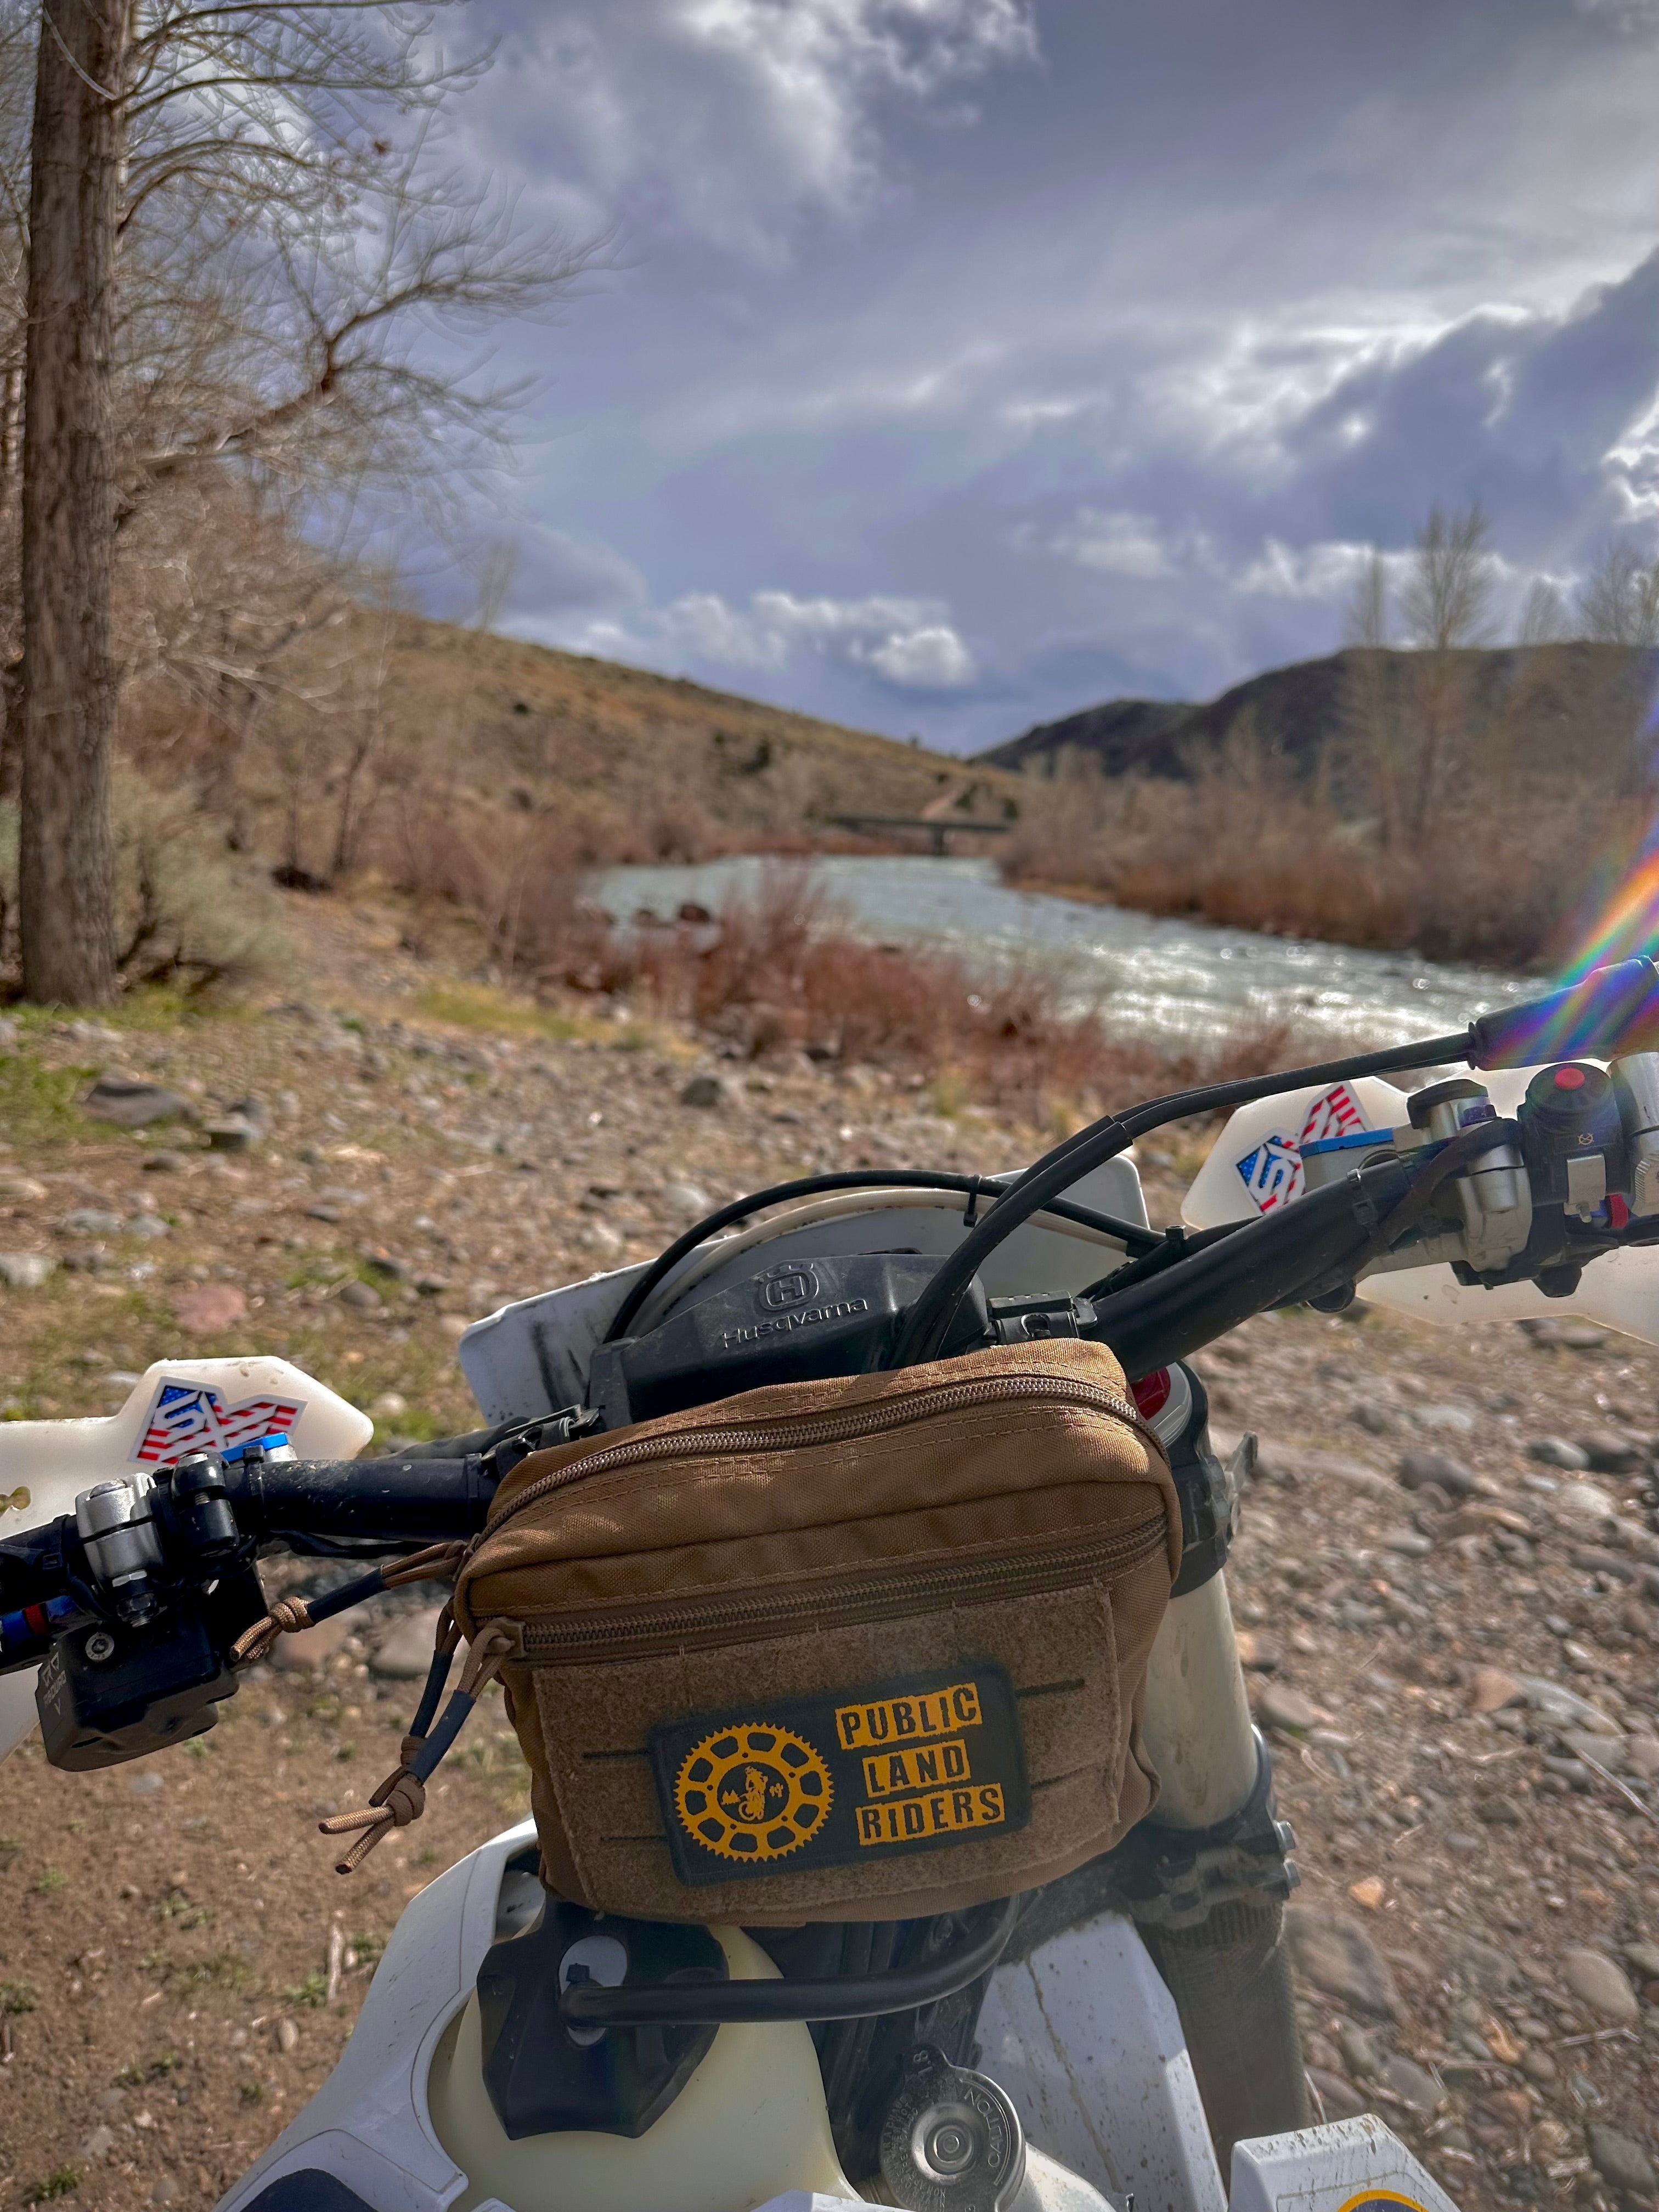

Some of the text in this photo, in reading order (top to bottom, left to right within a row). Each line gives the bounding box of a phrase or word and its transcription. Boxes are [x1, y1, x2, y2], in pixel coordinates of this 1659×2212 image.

[721, 1298, 868, 1348] Husqvarna
[840, 1686, 978, 1745] PUBLIC
[867, 1745, 965, 1793] LAND
[863, 1786, 1002, 1839] RIDERS
[963, 2087, 1003, 2168] CAUTION
